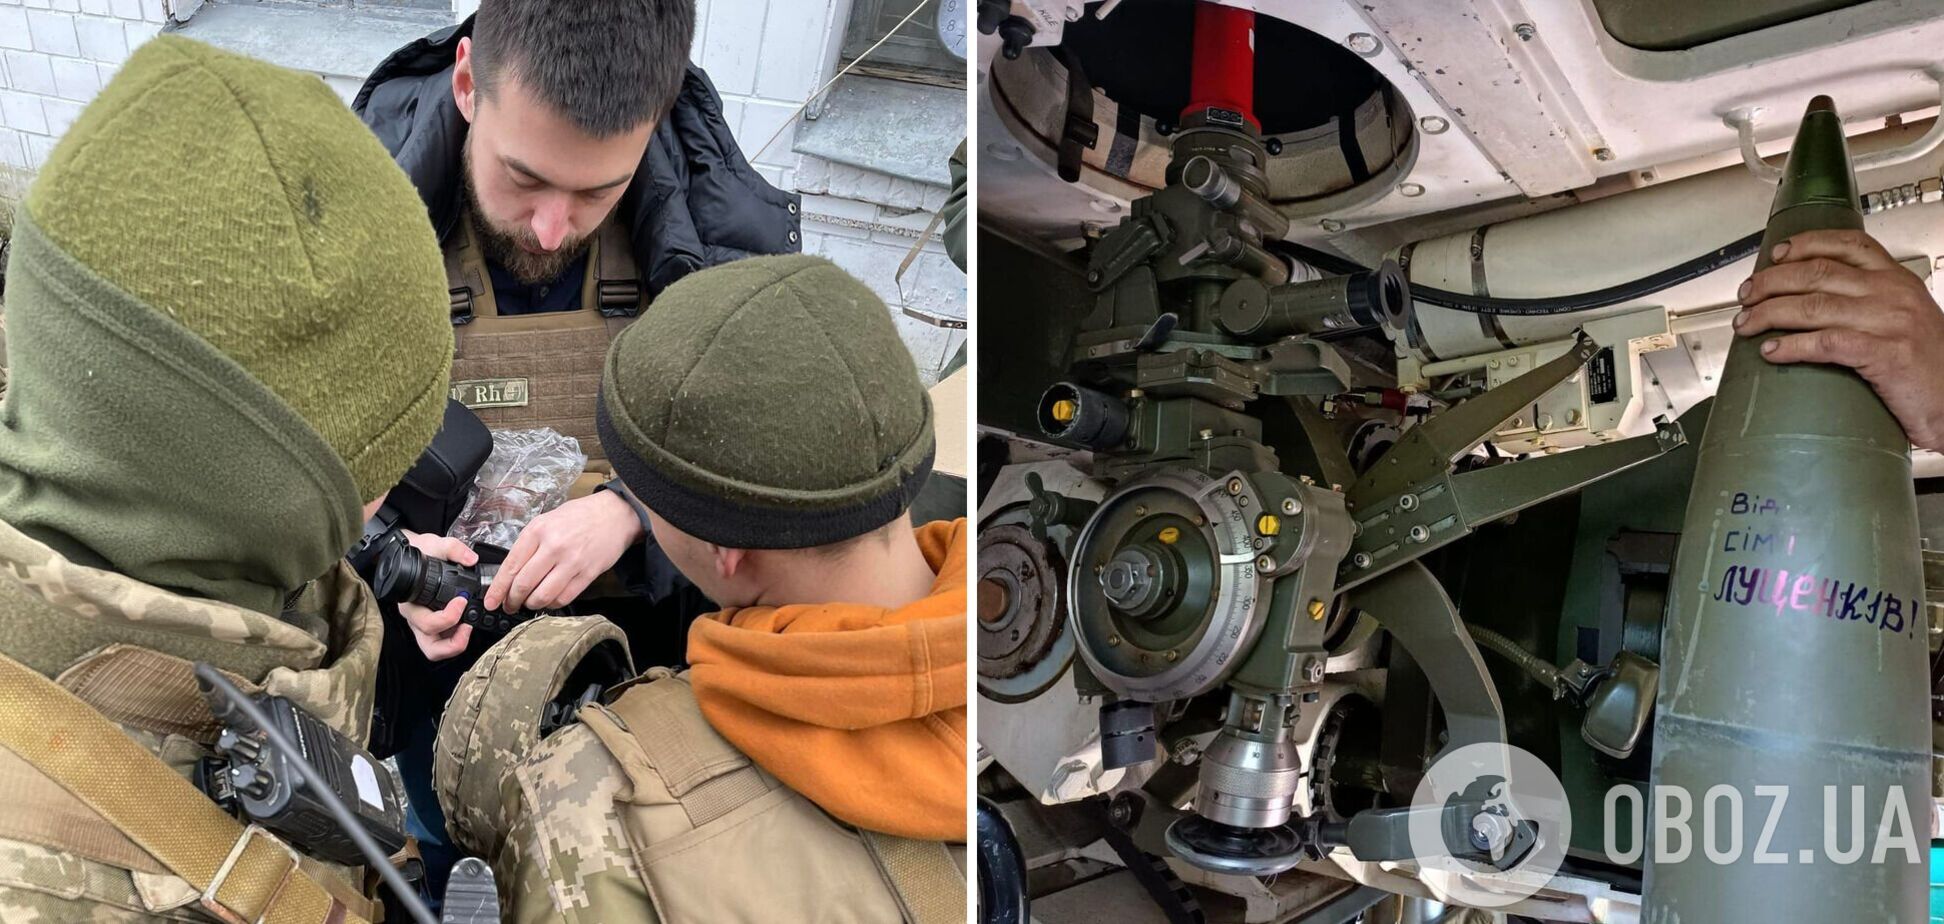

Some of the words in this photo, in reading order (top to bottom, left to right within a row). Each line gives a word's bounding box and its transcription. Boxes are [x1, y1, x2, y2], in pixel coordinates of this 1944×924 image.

[947, 0, 956, 12] 9
[946, 20, 955, 31] 8
[955, 35, 965, 46] 7
[1731, 493, 1779, 515] Від
[1244, 565, 1253, 579] 350
[1242, 596, 1252, 611] 300
[1231, 625, 1242, 639] 250
